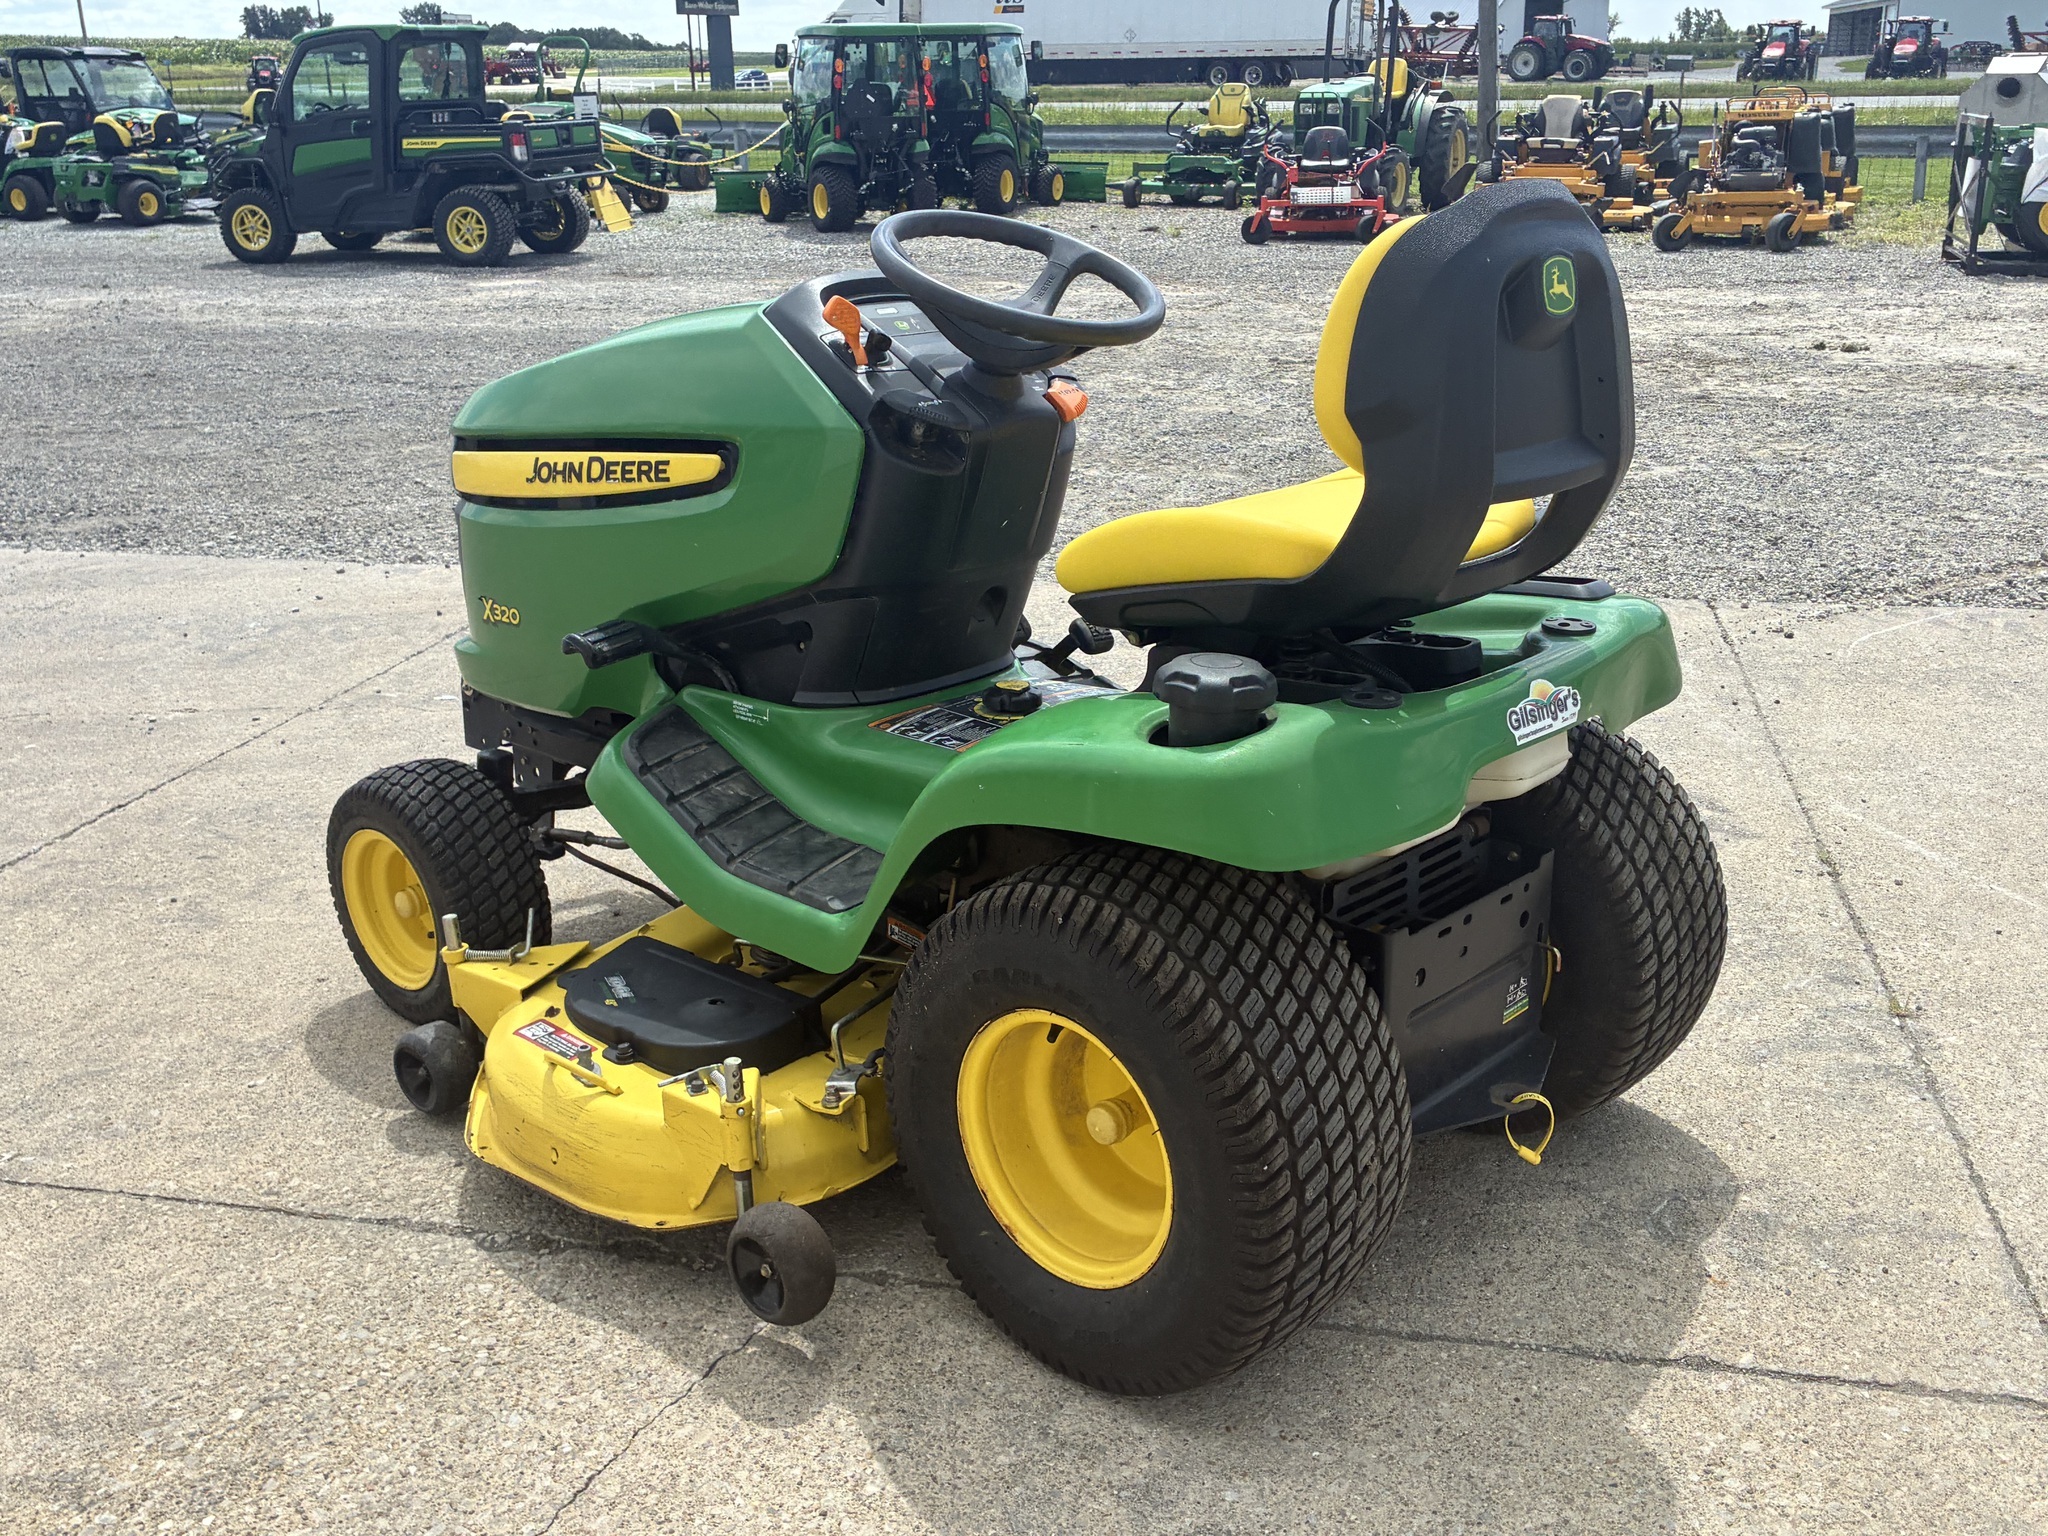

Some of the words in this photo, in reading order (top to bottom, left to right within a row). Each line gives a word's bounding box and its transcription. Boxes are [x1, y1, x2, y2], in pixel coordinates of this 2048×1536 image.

[1030, 274, 1056, 302] DEERE
[526, 456, 583, 483] JOHN
[586, 456, 671, 483] DEERE
[479, 595, 521, 625] X320
[1508, 688, 1579, 731] Gilsinger's
